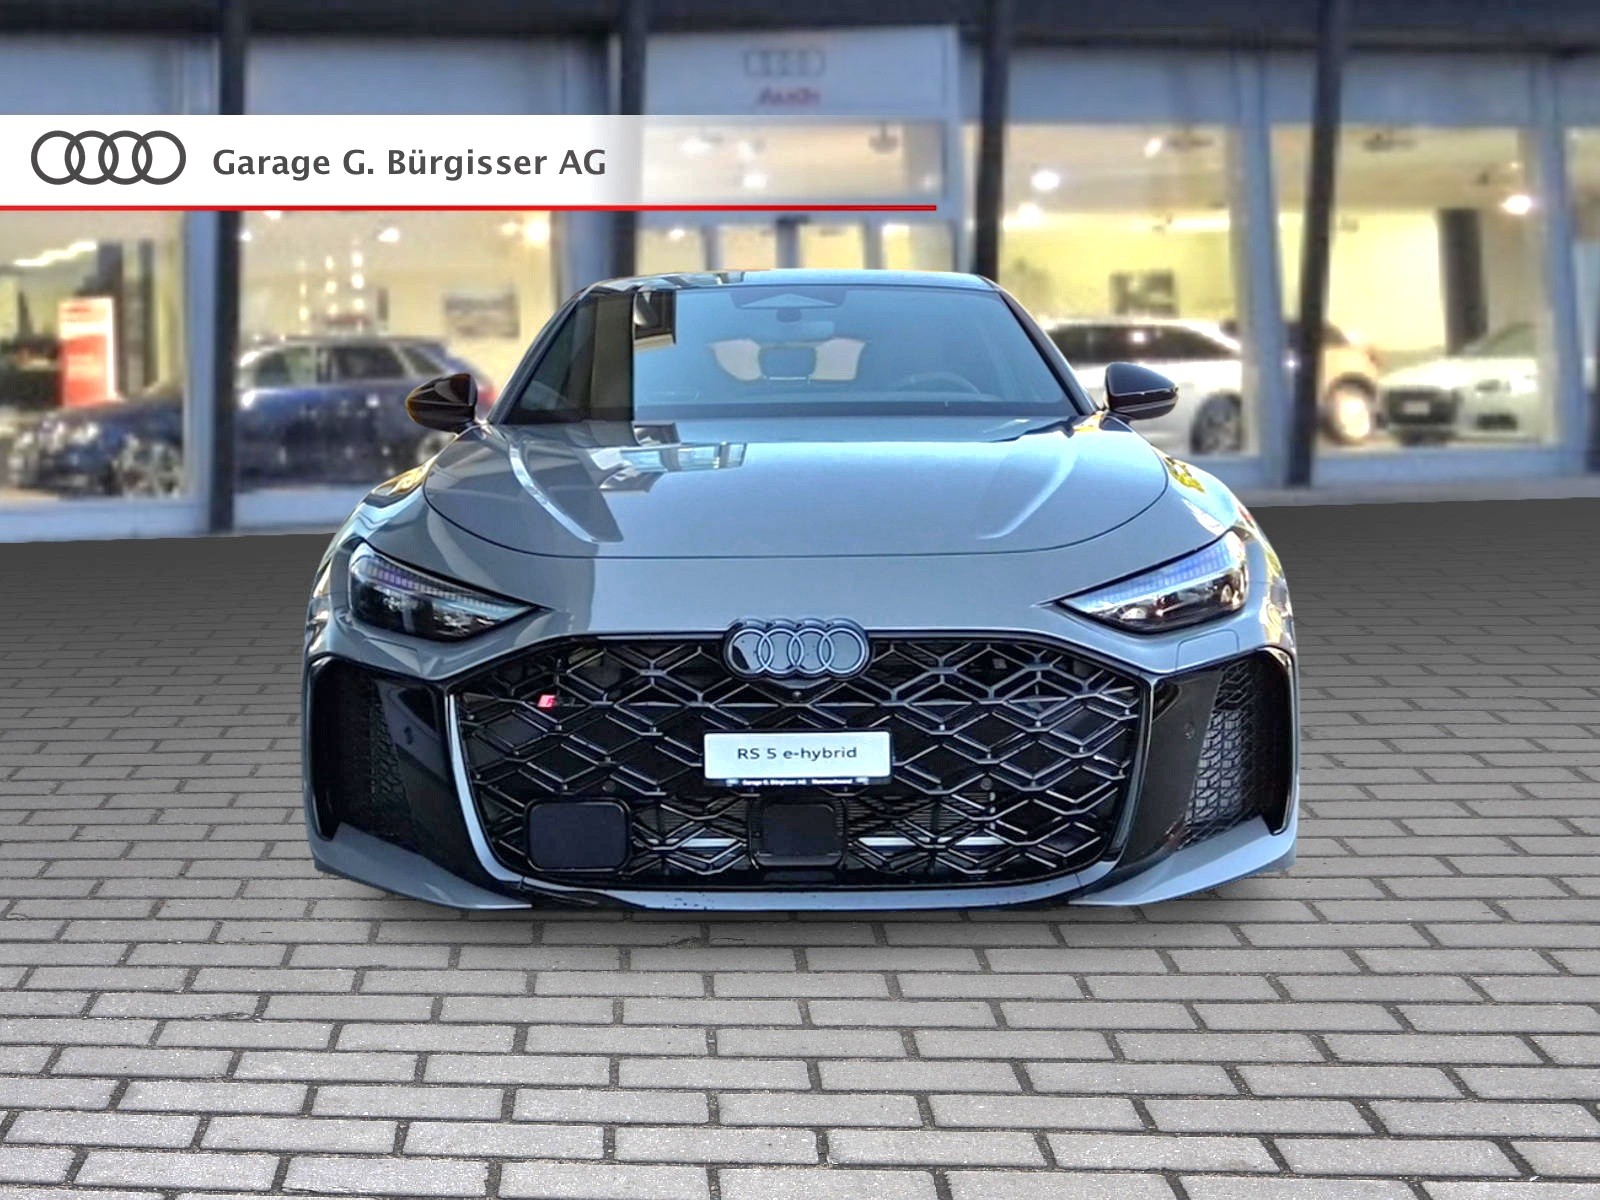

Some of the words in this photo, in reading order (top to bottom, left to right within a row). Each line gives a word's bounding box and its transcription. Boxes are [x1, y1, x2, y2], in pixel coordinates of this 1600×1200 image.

[737, 748, 760, 760] RS
[767, 748, 777, 760] 5
[783, 747, 857, 762] e-hybrid
